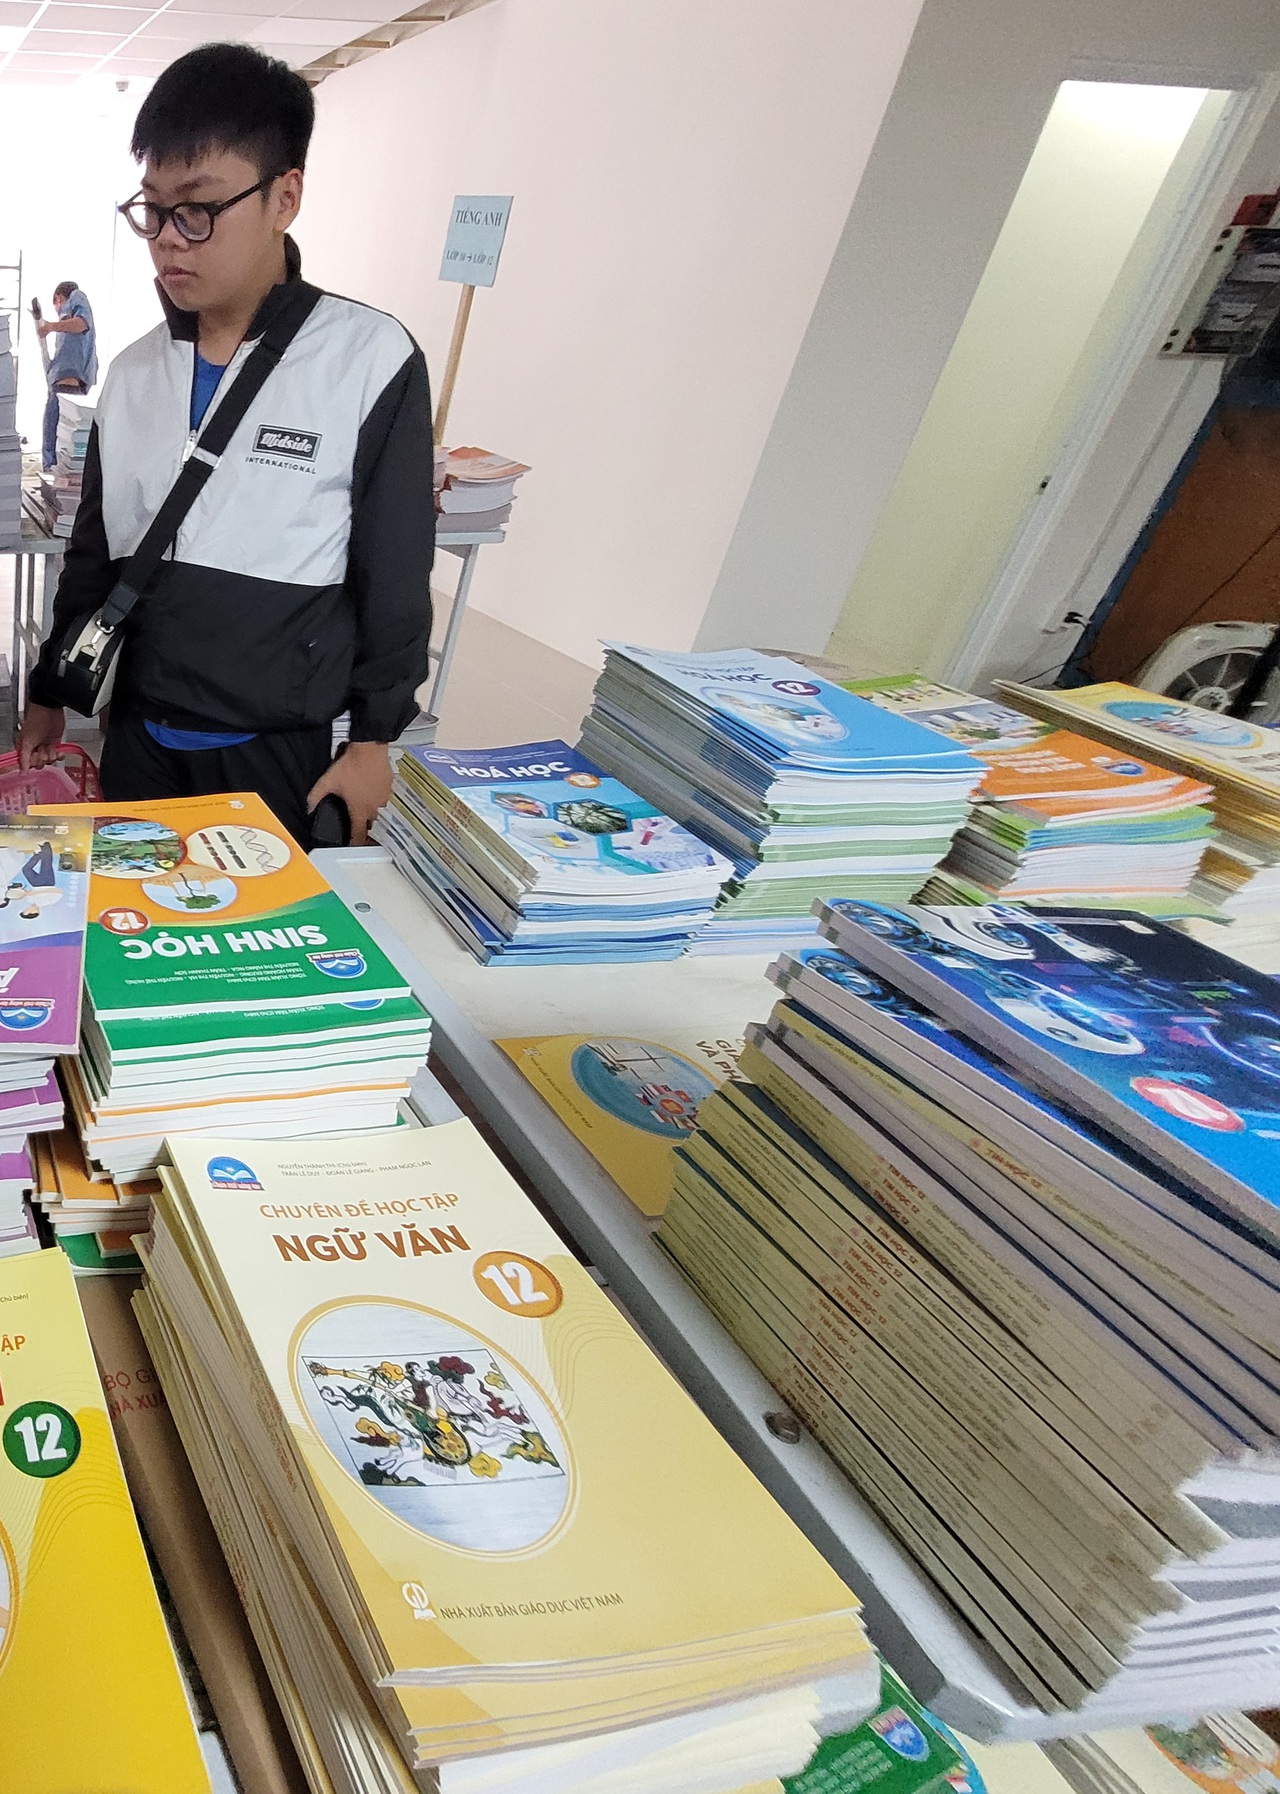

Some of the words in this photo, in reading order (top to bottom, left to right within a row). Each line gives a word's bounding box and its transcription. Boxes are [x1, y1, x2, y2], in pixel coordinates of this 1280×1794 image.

[456, 208, 482, 225] TIẾNG
[483, 212, 504, 226] ANH
[245, 456, 316, 475] INTERNATIONAL
[723, 673, 773, 684] HỌC
[777, 682, 817, 694] 12
[450, 766, 511, 779] HOÁ
[508, 761, 572, 778] HỌC
[109, 911, 147, 931] 12
[119, 932, 221, 960] HỌC
[223, 925, 328, 955] SINH
[694, 1040, 720, 1058] VÀ
[714, 1061, 742, 1080] PH
[353, 1167, 374, 1176] GIANG
[379, 1164, 398, 1174] PHẠM
[398, 1163, 418, 1173] NGỌC
[418, 1160, 432, 1170] LAN
[259, 1202, 343, 1220] CHUYÊN
[344, 1199, 375, 1218] ĐỀ
[374, 1198, 422, 1218] HỌC
[419, 1192, 460, 1213] TẬP
[272, 1227, 369, 1262] NGỮ
[373, 1222, 472, 1258] VĂN
[480, 1261, 550, 1306] 12
[0, 1295, 13, 1304] Chủ
[13, 1293, 29, 1303] biên)
[104, 1370, 131, 1392] BỘ
[135, 1393, 159, 1410] XU
[14, 1416, 69, 1462] 12
[439, 1606, 465, 1620] NHÀ
[466, 1602, 494, 1619] XUẤT
[494, 1601, 519, 1618] BẢN
[518, 1600, 548, 1616] GIÁO
[548, 1599, 573, 1616] DỤC
[572, 1595, 596, 1613] VIỆT
[596, 1592, 624, 1607] NAM
